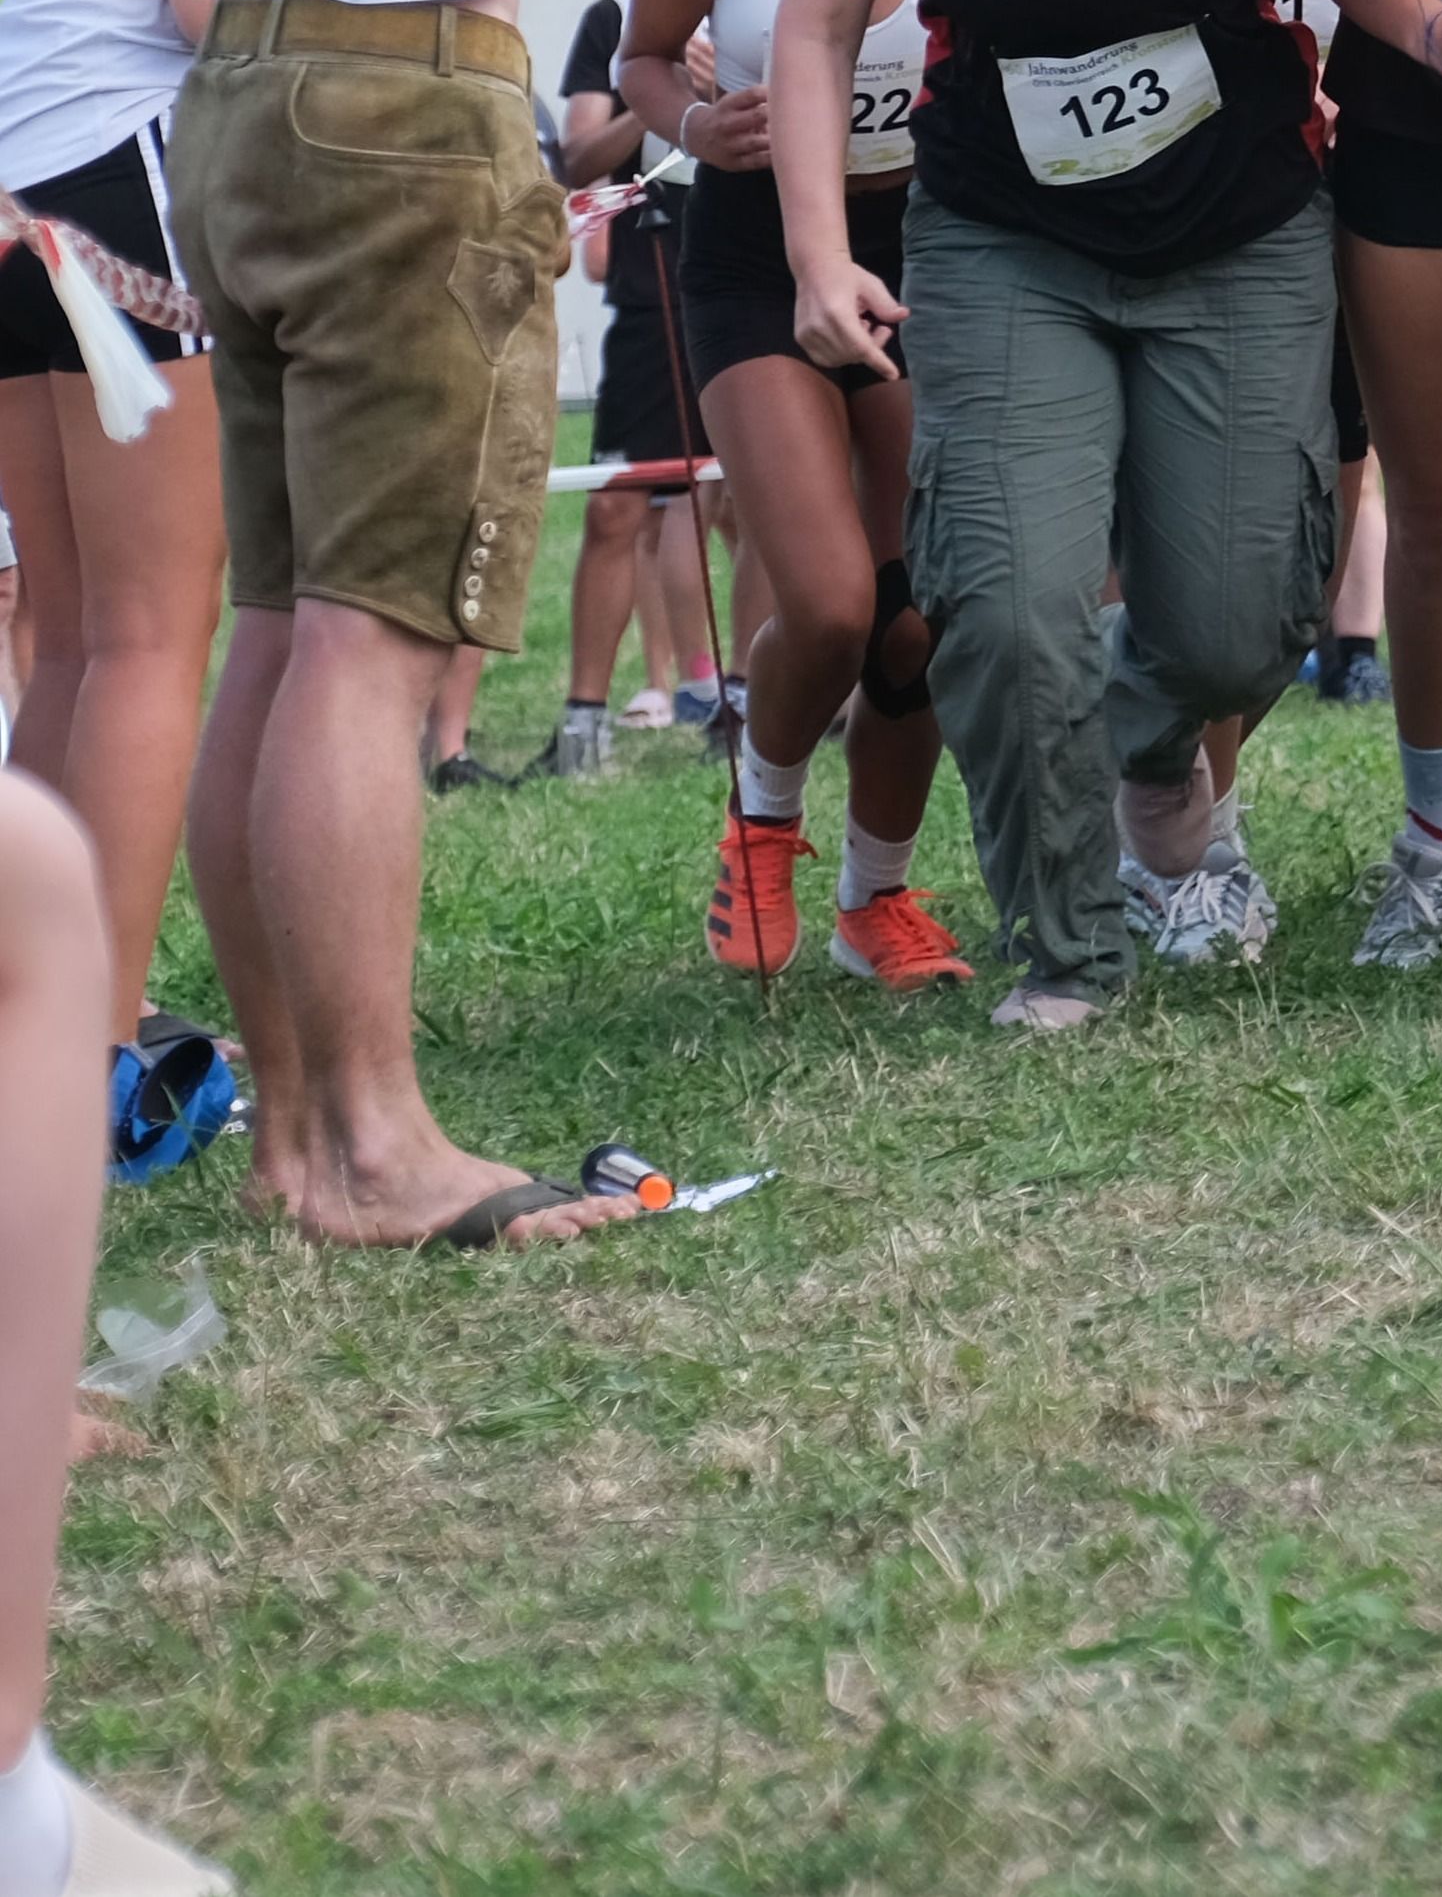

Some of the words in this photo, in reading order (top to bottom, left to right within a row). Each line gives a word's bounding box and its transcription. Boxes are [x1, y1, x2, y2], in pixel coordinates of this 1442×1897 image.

[1028, 41, 1138, 77] Jahnwanderung
[850, 88, 913, 134] 22
[1059, 68, 1170, 139] 123
